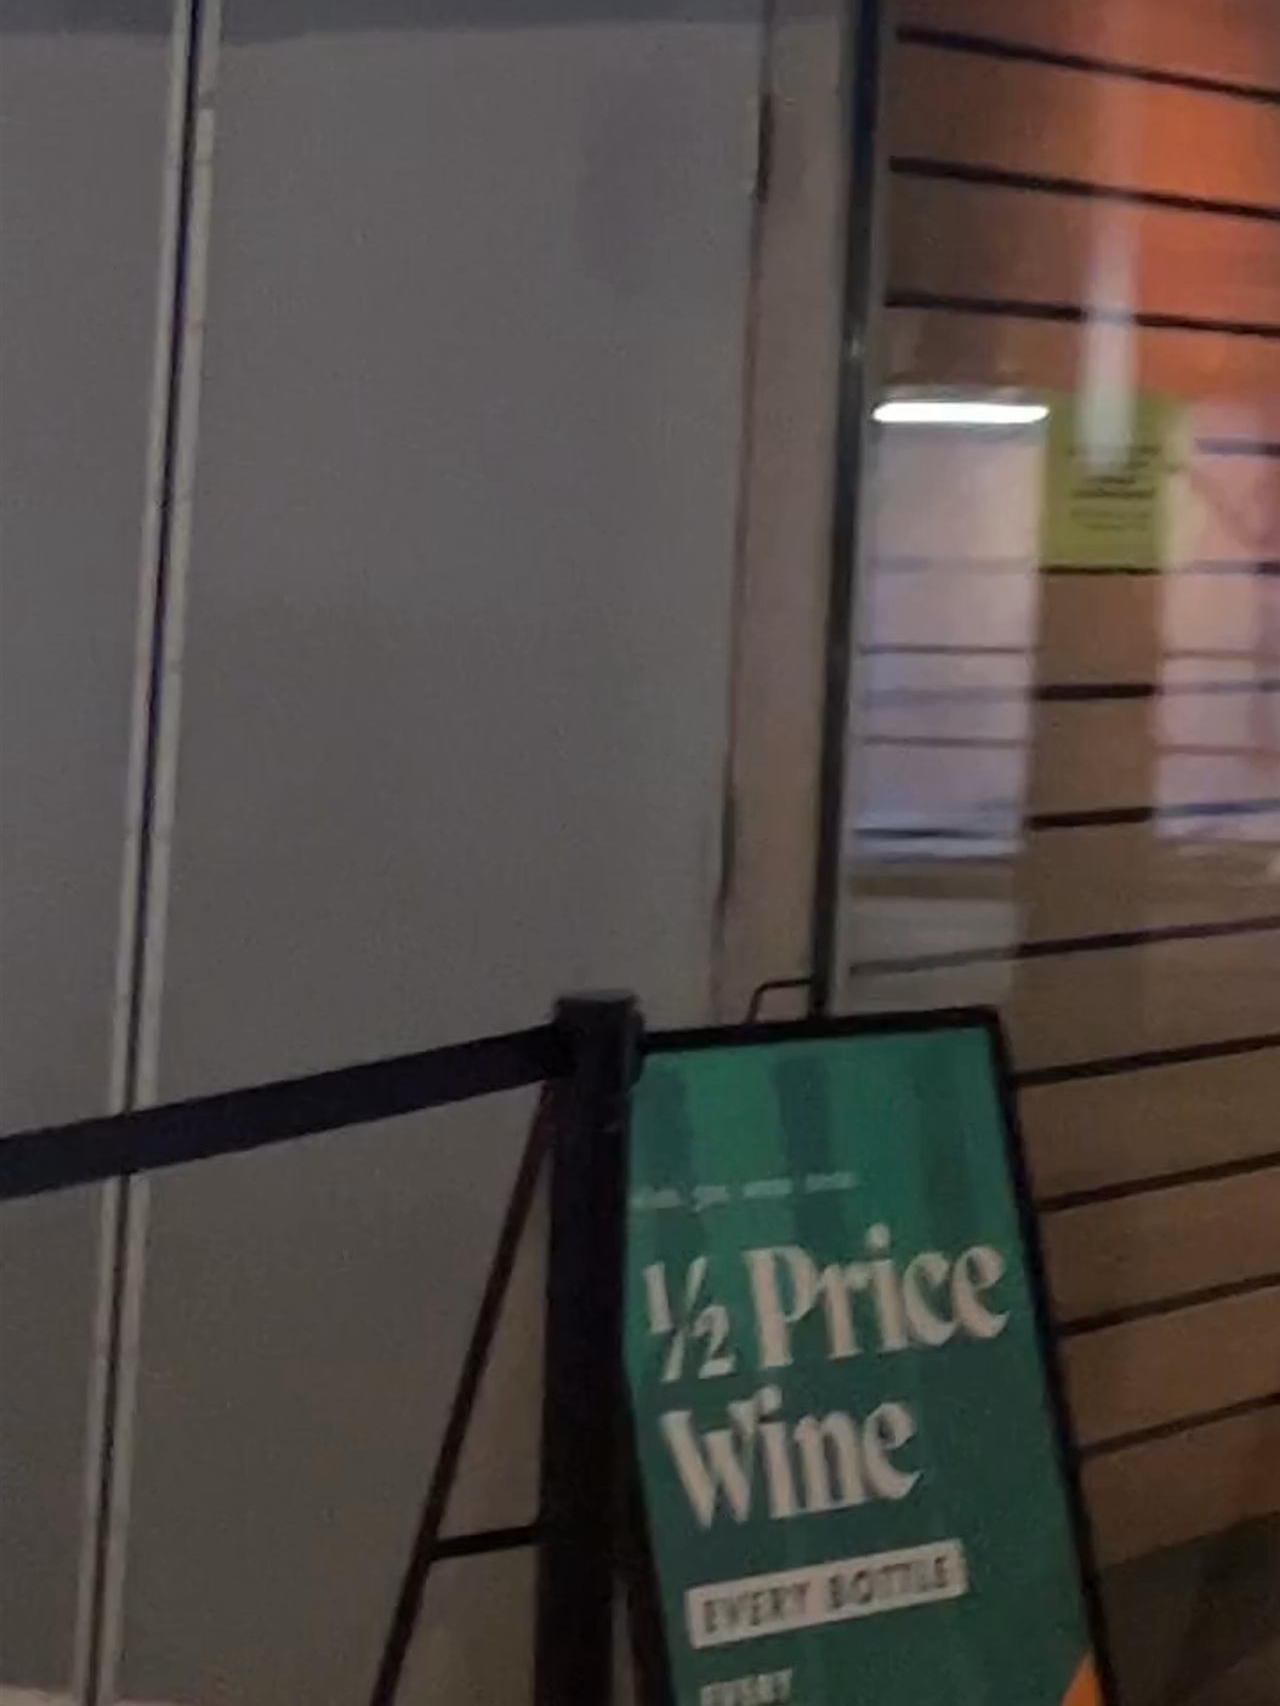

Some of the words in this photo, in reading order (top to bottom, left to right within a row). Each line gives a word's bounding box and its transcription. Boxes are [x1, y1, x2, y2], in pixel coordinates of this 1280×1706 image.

[741, 1222, 1010, 1369] Price
[659, 1384, 925, 1529] Wine
[702, 1580, 812, 1635] EVERY
